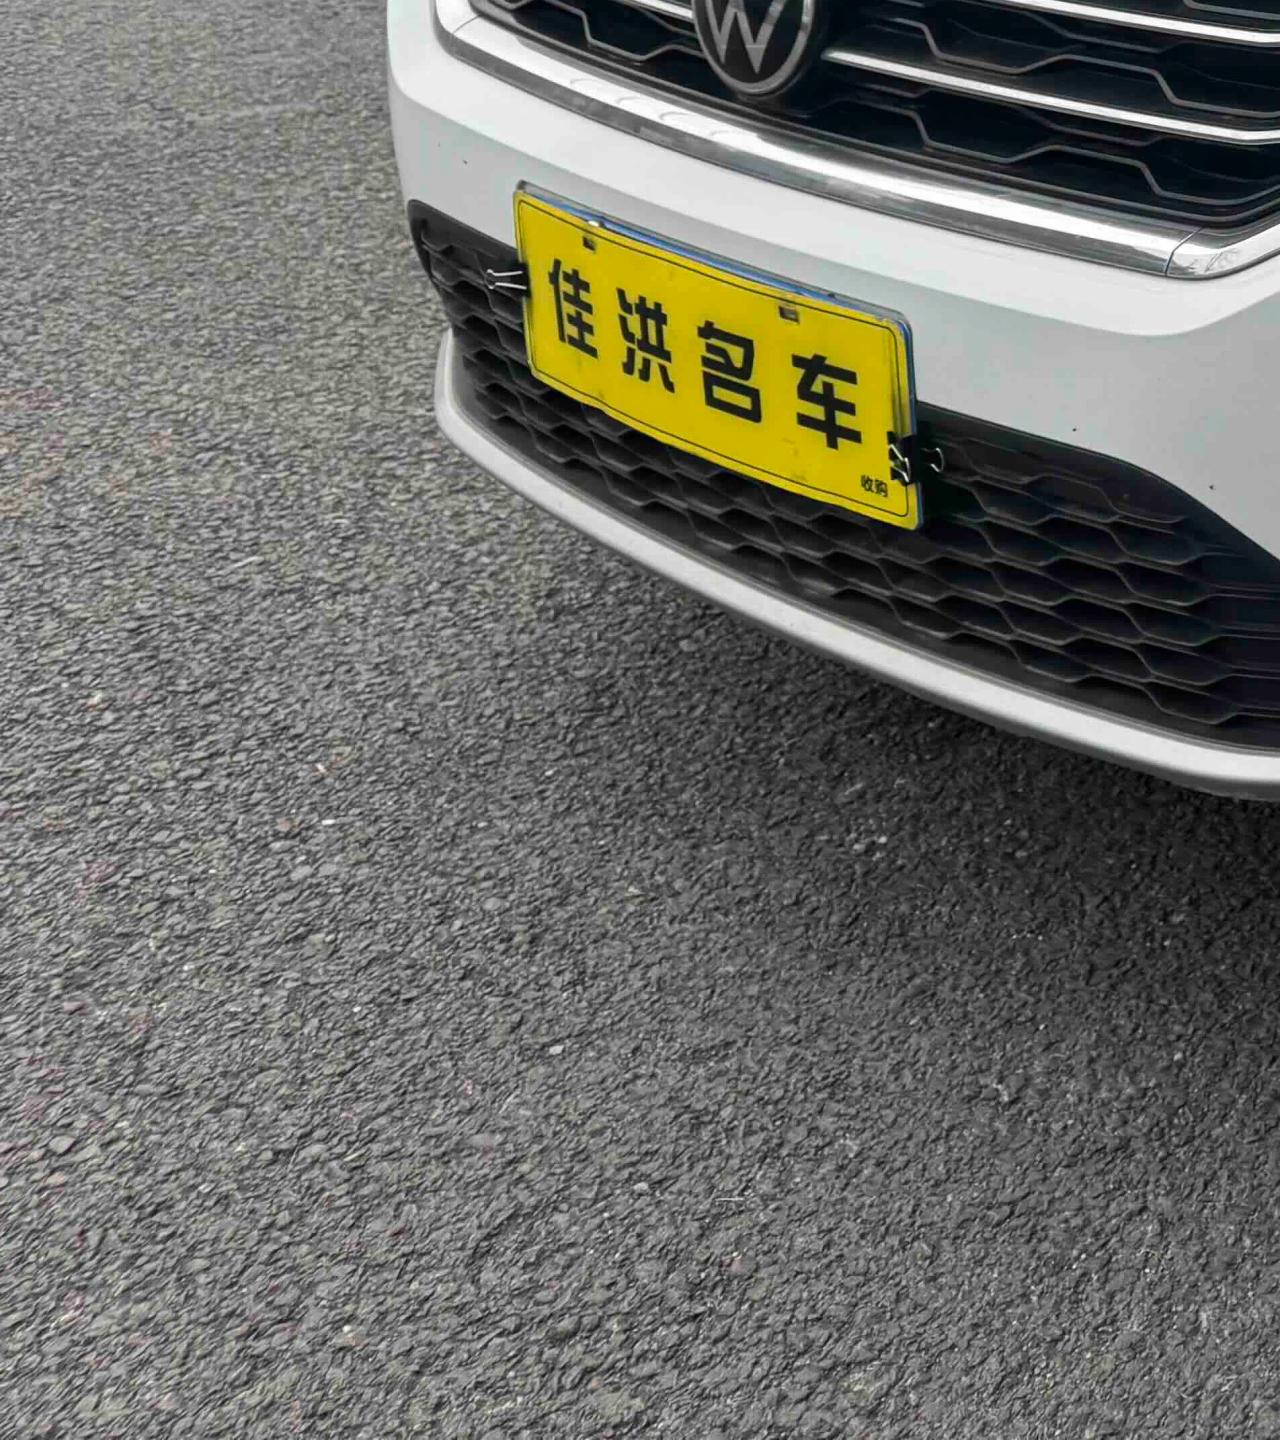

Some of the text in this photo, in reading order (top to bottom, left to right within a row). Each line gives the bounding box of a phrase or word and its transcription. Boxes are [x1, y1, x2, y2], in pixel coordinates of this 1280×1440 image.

[548, 258, 863, 451] 佳洪名车
[860, 474, 889, 498] 收购
